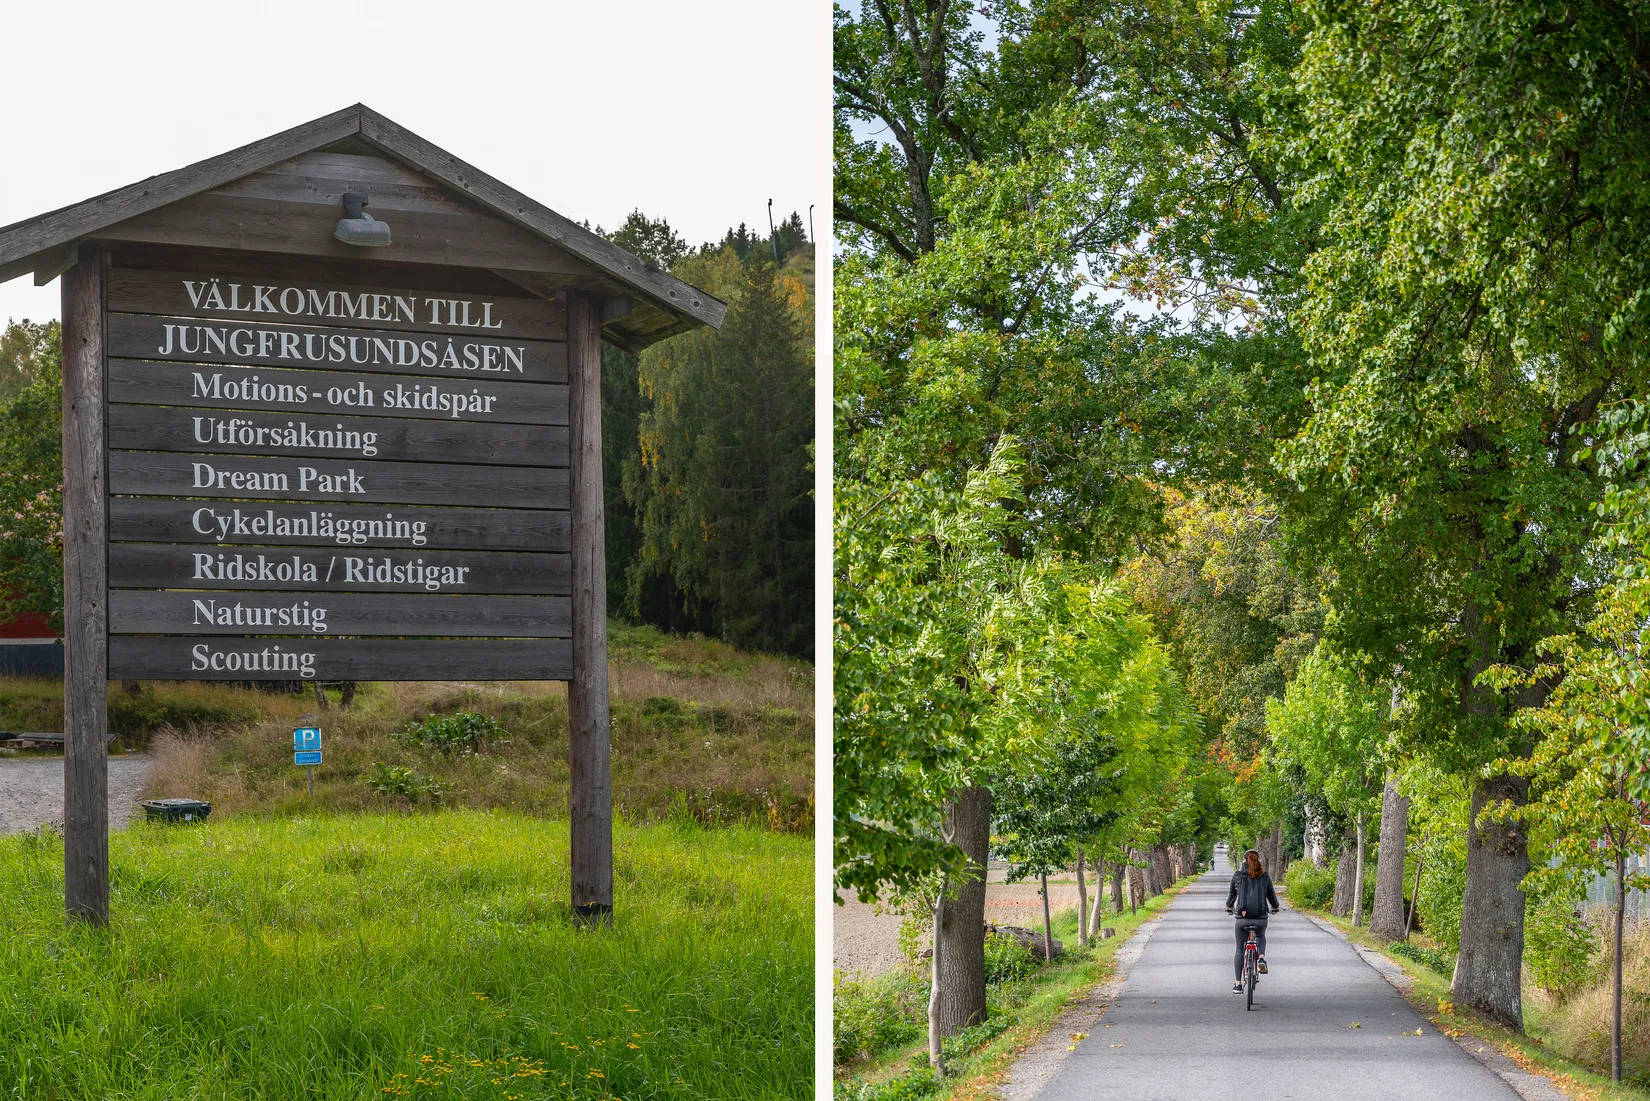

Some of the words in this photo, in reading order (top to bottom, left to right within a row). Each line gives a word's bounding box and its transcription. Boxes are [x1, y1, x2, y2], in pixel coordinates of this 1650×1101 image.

[182, 278, 416, 324] VÄLKOMMEN
[425, 297, 503, 330] TILL
[157, 323, 526, 374] JUNGFRUSUNDSÅSEN
[383, 383, 497, 419] skidspår
[192, 416, 378, 456] Utförsåkning
[191, 462, 290, 493] Dream
[298, 466, 366, 494] Park
[191, 507, 428, 546] Cykelanläggning
[191, 552, 319, 582] Ridskola
[343, 556, 470, 591] Ridstigar
[191, 599, 328, 633] Naturstig
[191, 643, 316, 678] Scouting
[302, 729, 315, 748] P
